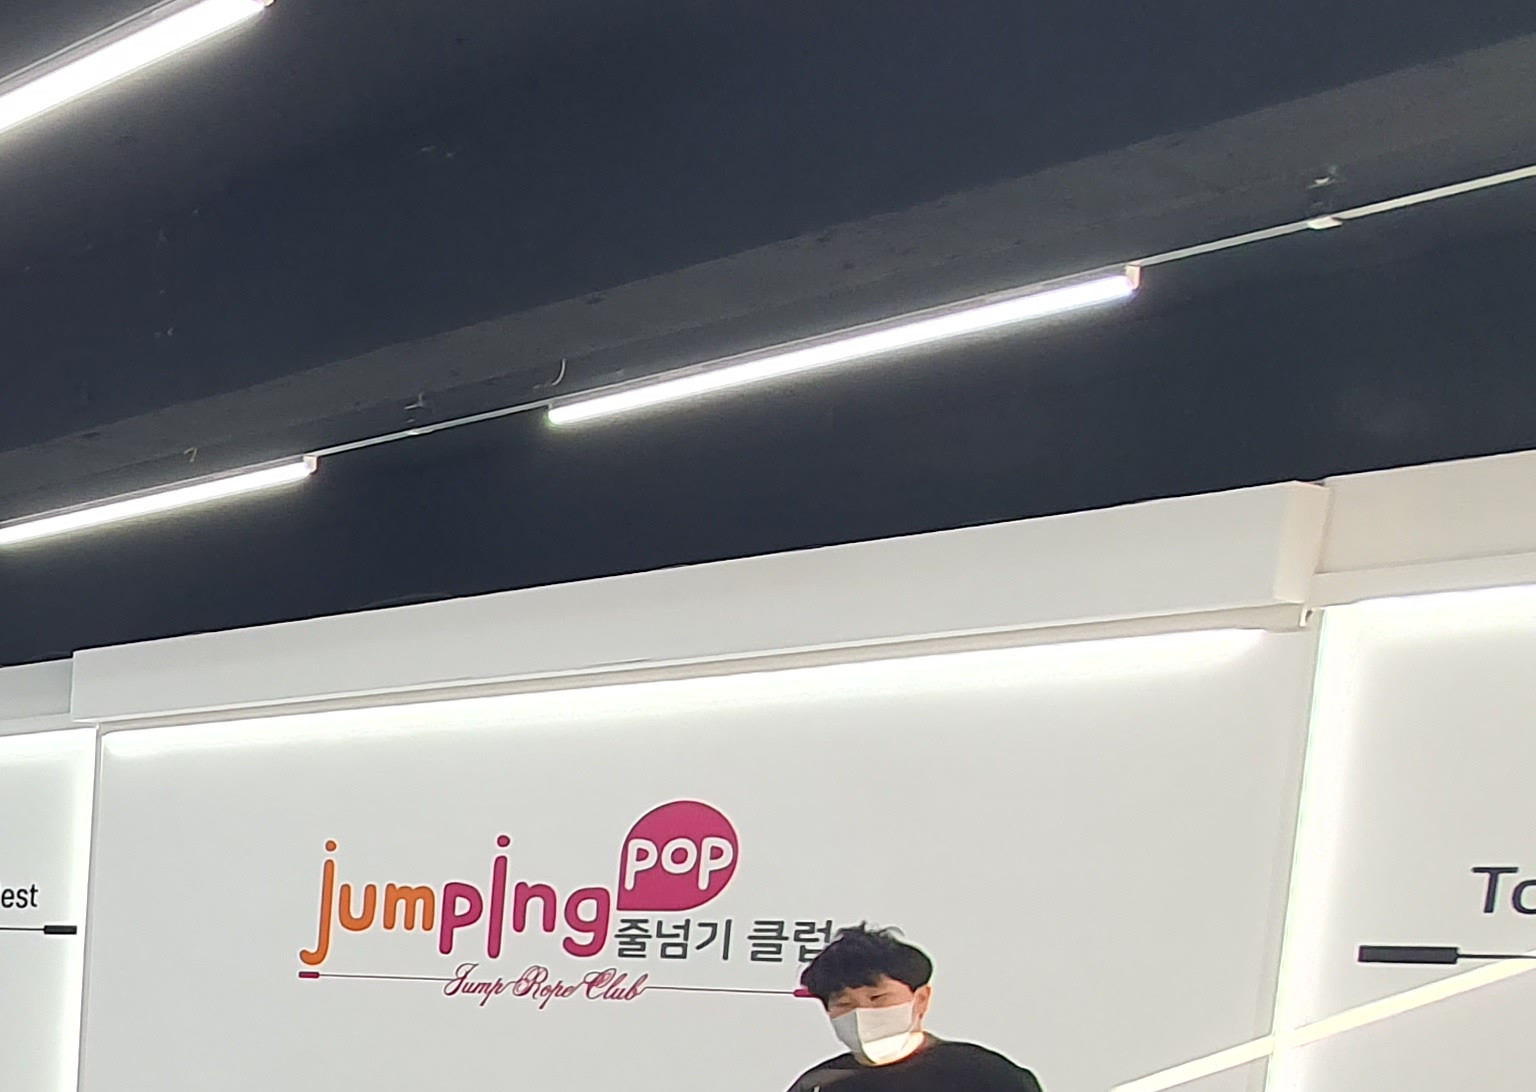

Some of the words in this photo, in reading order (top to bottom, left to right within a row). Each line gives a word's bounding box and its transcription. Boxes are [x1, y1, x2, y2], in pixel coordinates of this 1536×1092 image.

[299, 835, 611, 966] jumping
[614, 918, 732, 960] 줄넘기
[747, 919, 833, 963] 클럽
[444, 963, 504, 1007] Jump
[513, 965, 578, 1009] Rope
[584, 968, 648, 1000] Club
